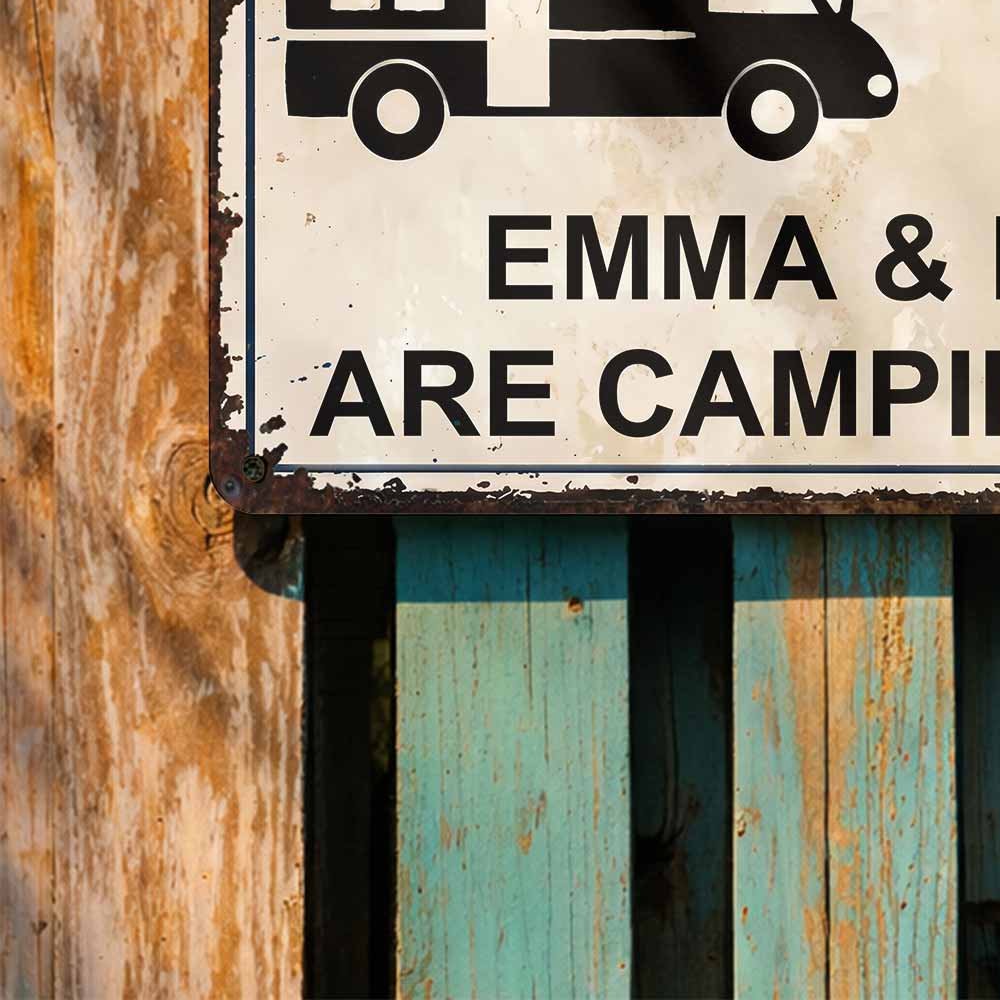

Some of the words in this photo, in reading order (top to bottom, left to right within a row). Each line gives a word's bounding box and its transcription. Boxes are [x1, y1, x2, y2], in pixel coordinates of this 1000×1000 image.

[488, 215, 837, 300] EMMA
[875, 213, 953, 302] &
[309, 350, 556, 437] ARE
